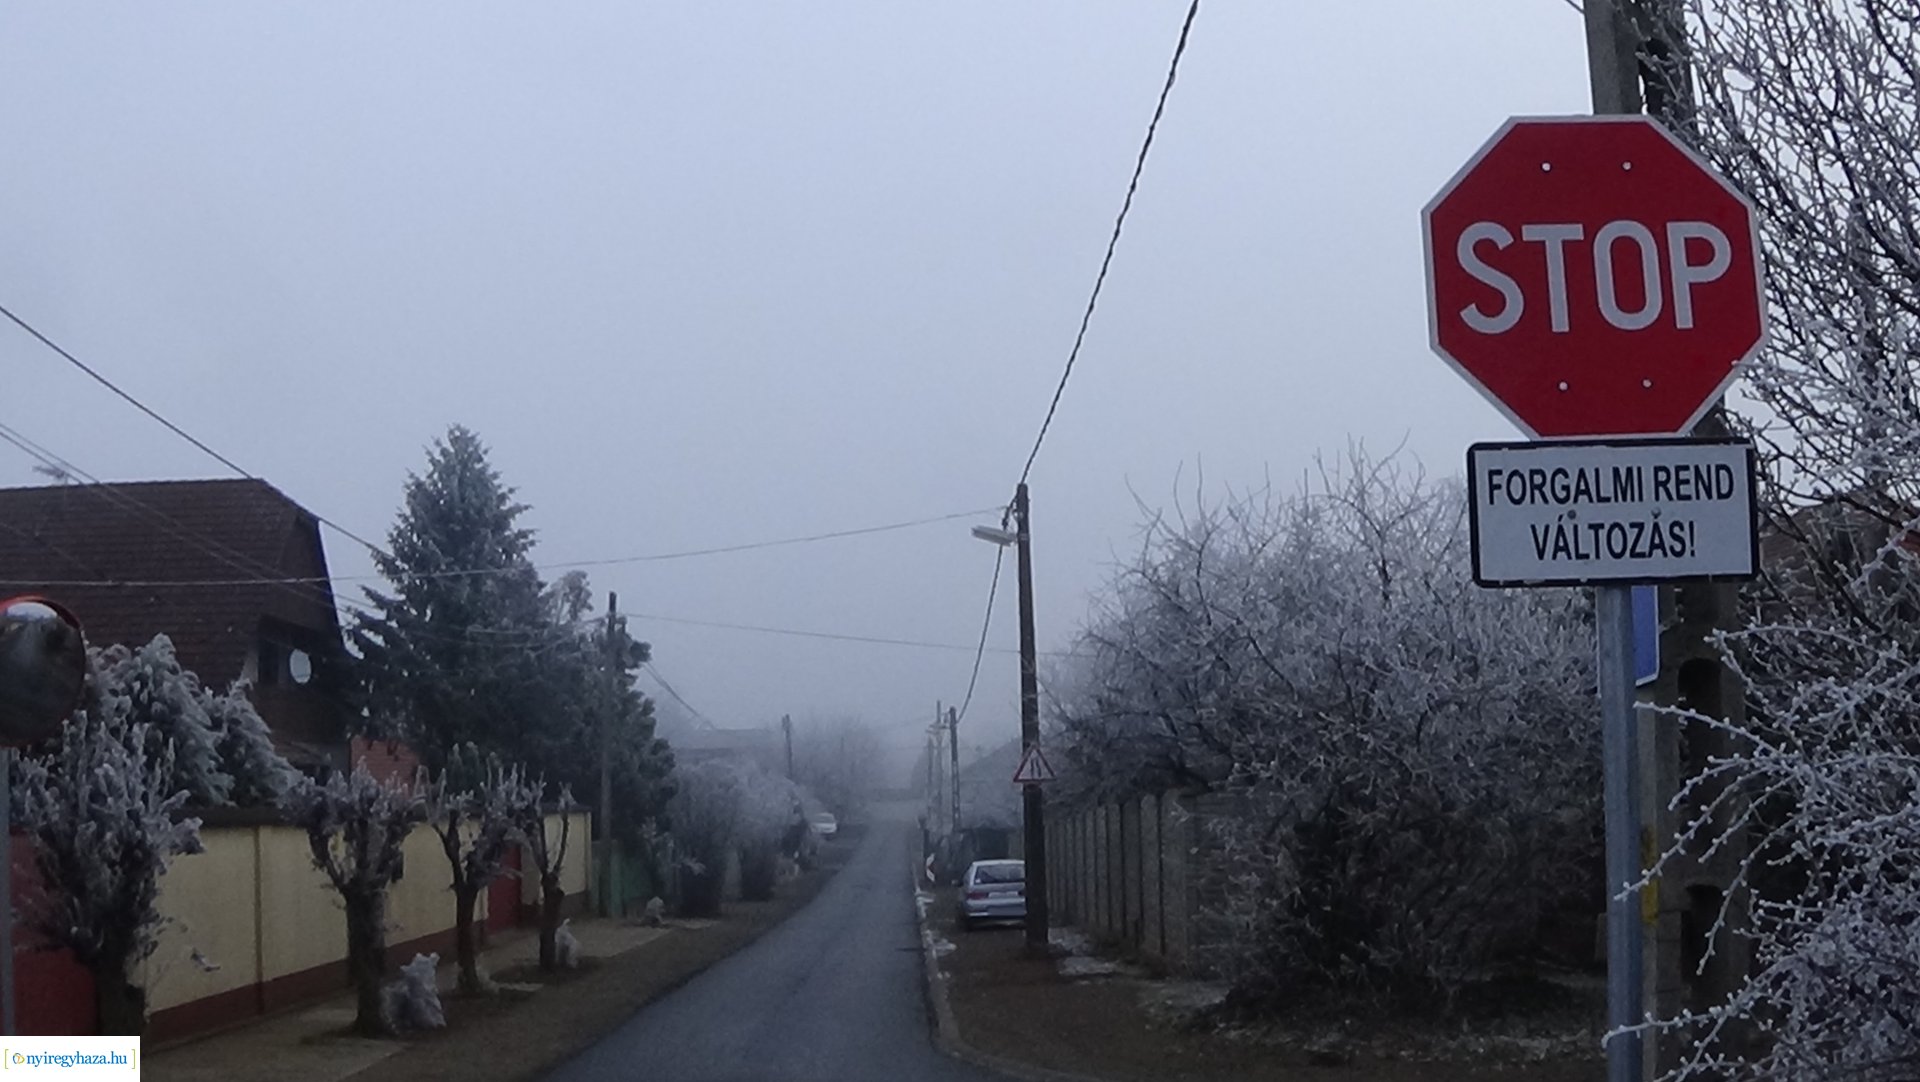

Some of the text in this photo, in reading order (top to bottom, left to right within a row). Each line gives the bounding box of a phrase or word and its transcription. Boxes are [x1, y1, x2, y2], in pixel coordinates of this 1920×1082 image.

[1457, 220, 1732, 334] STOP
[1487, 463, 1735, 505] FORGALMI REND
[1530, 514, 1696, 561] VÁLTOZÁS!
